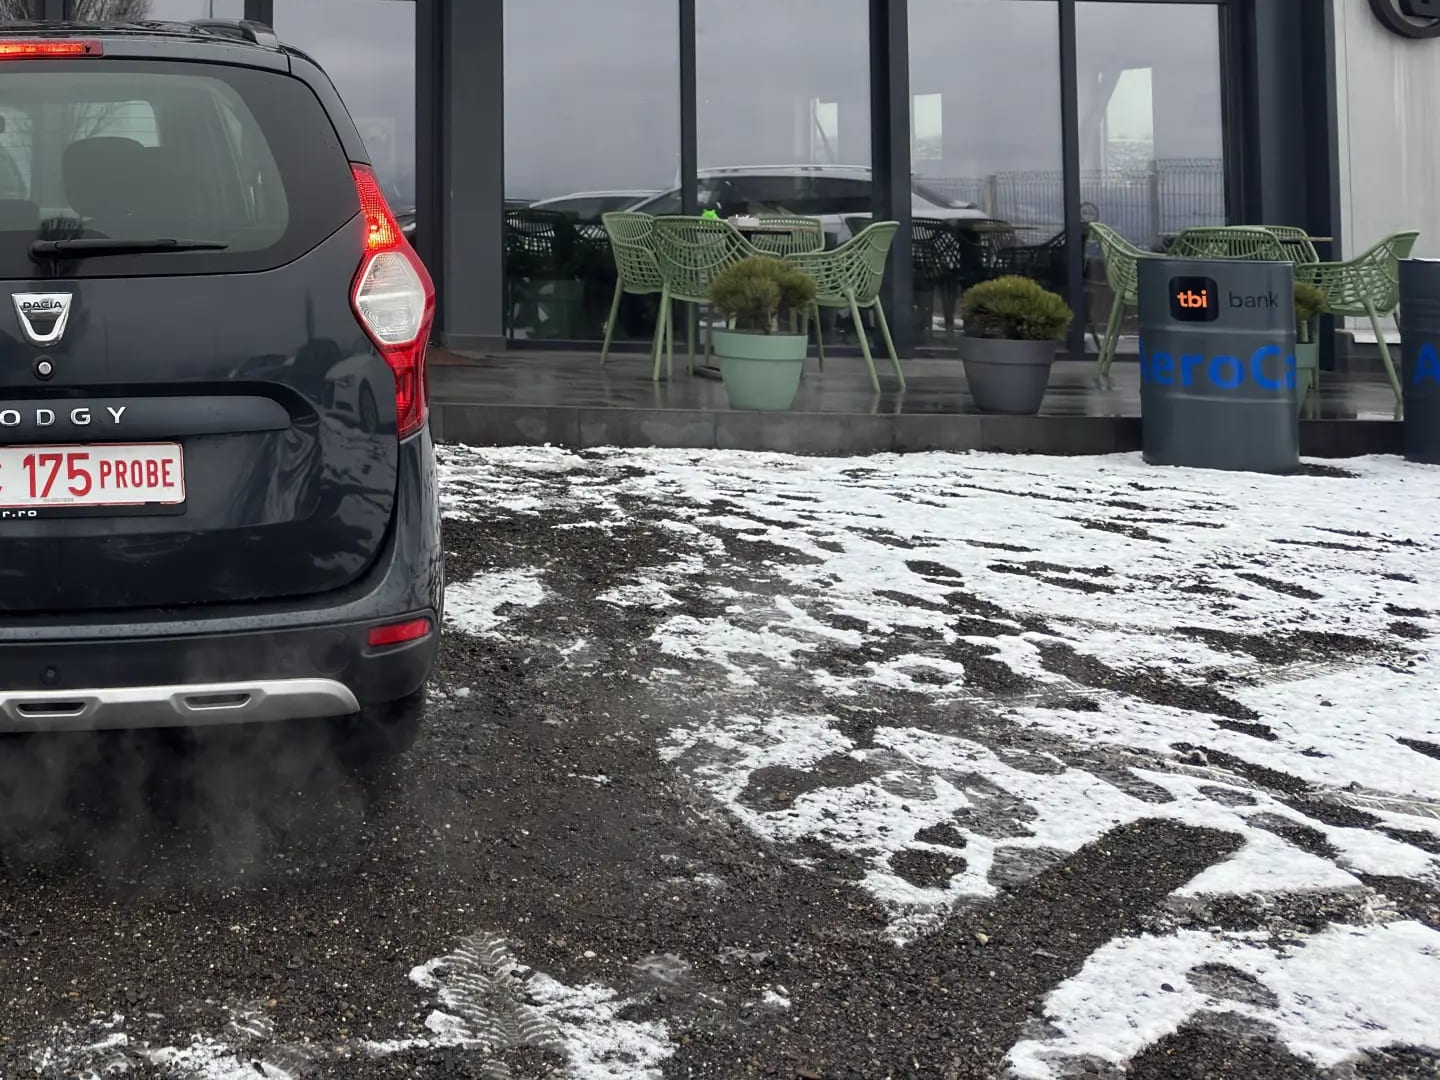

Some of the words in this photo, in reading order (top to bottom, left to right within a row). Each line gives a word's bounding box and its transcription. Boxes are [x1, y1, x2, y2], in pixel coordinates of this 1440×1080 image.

[23, 301, 63, 309] DACIA
[1177, 289, 1208, 308] tbi
[1229, 291, 1279, 309] bank
[22, 453, 92, 498] 175
[99, 458, 175, 489] PROBE
